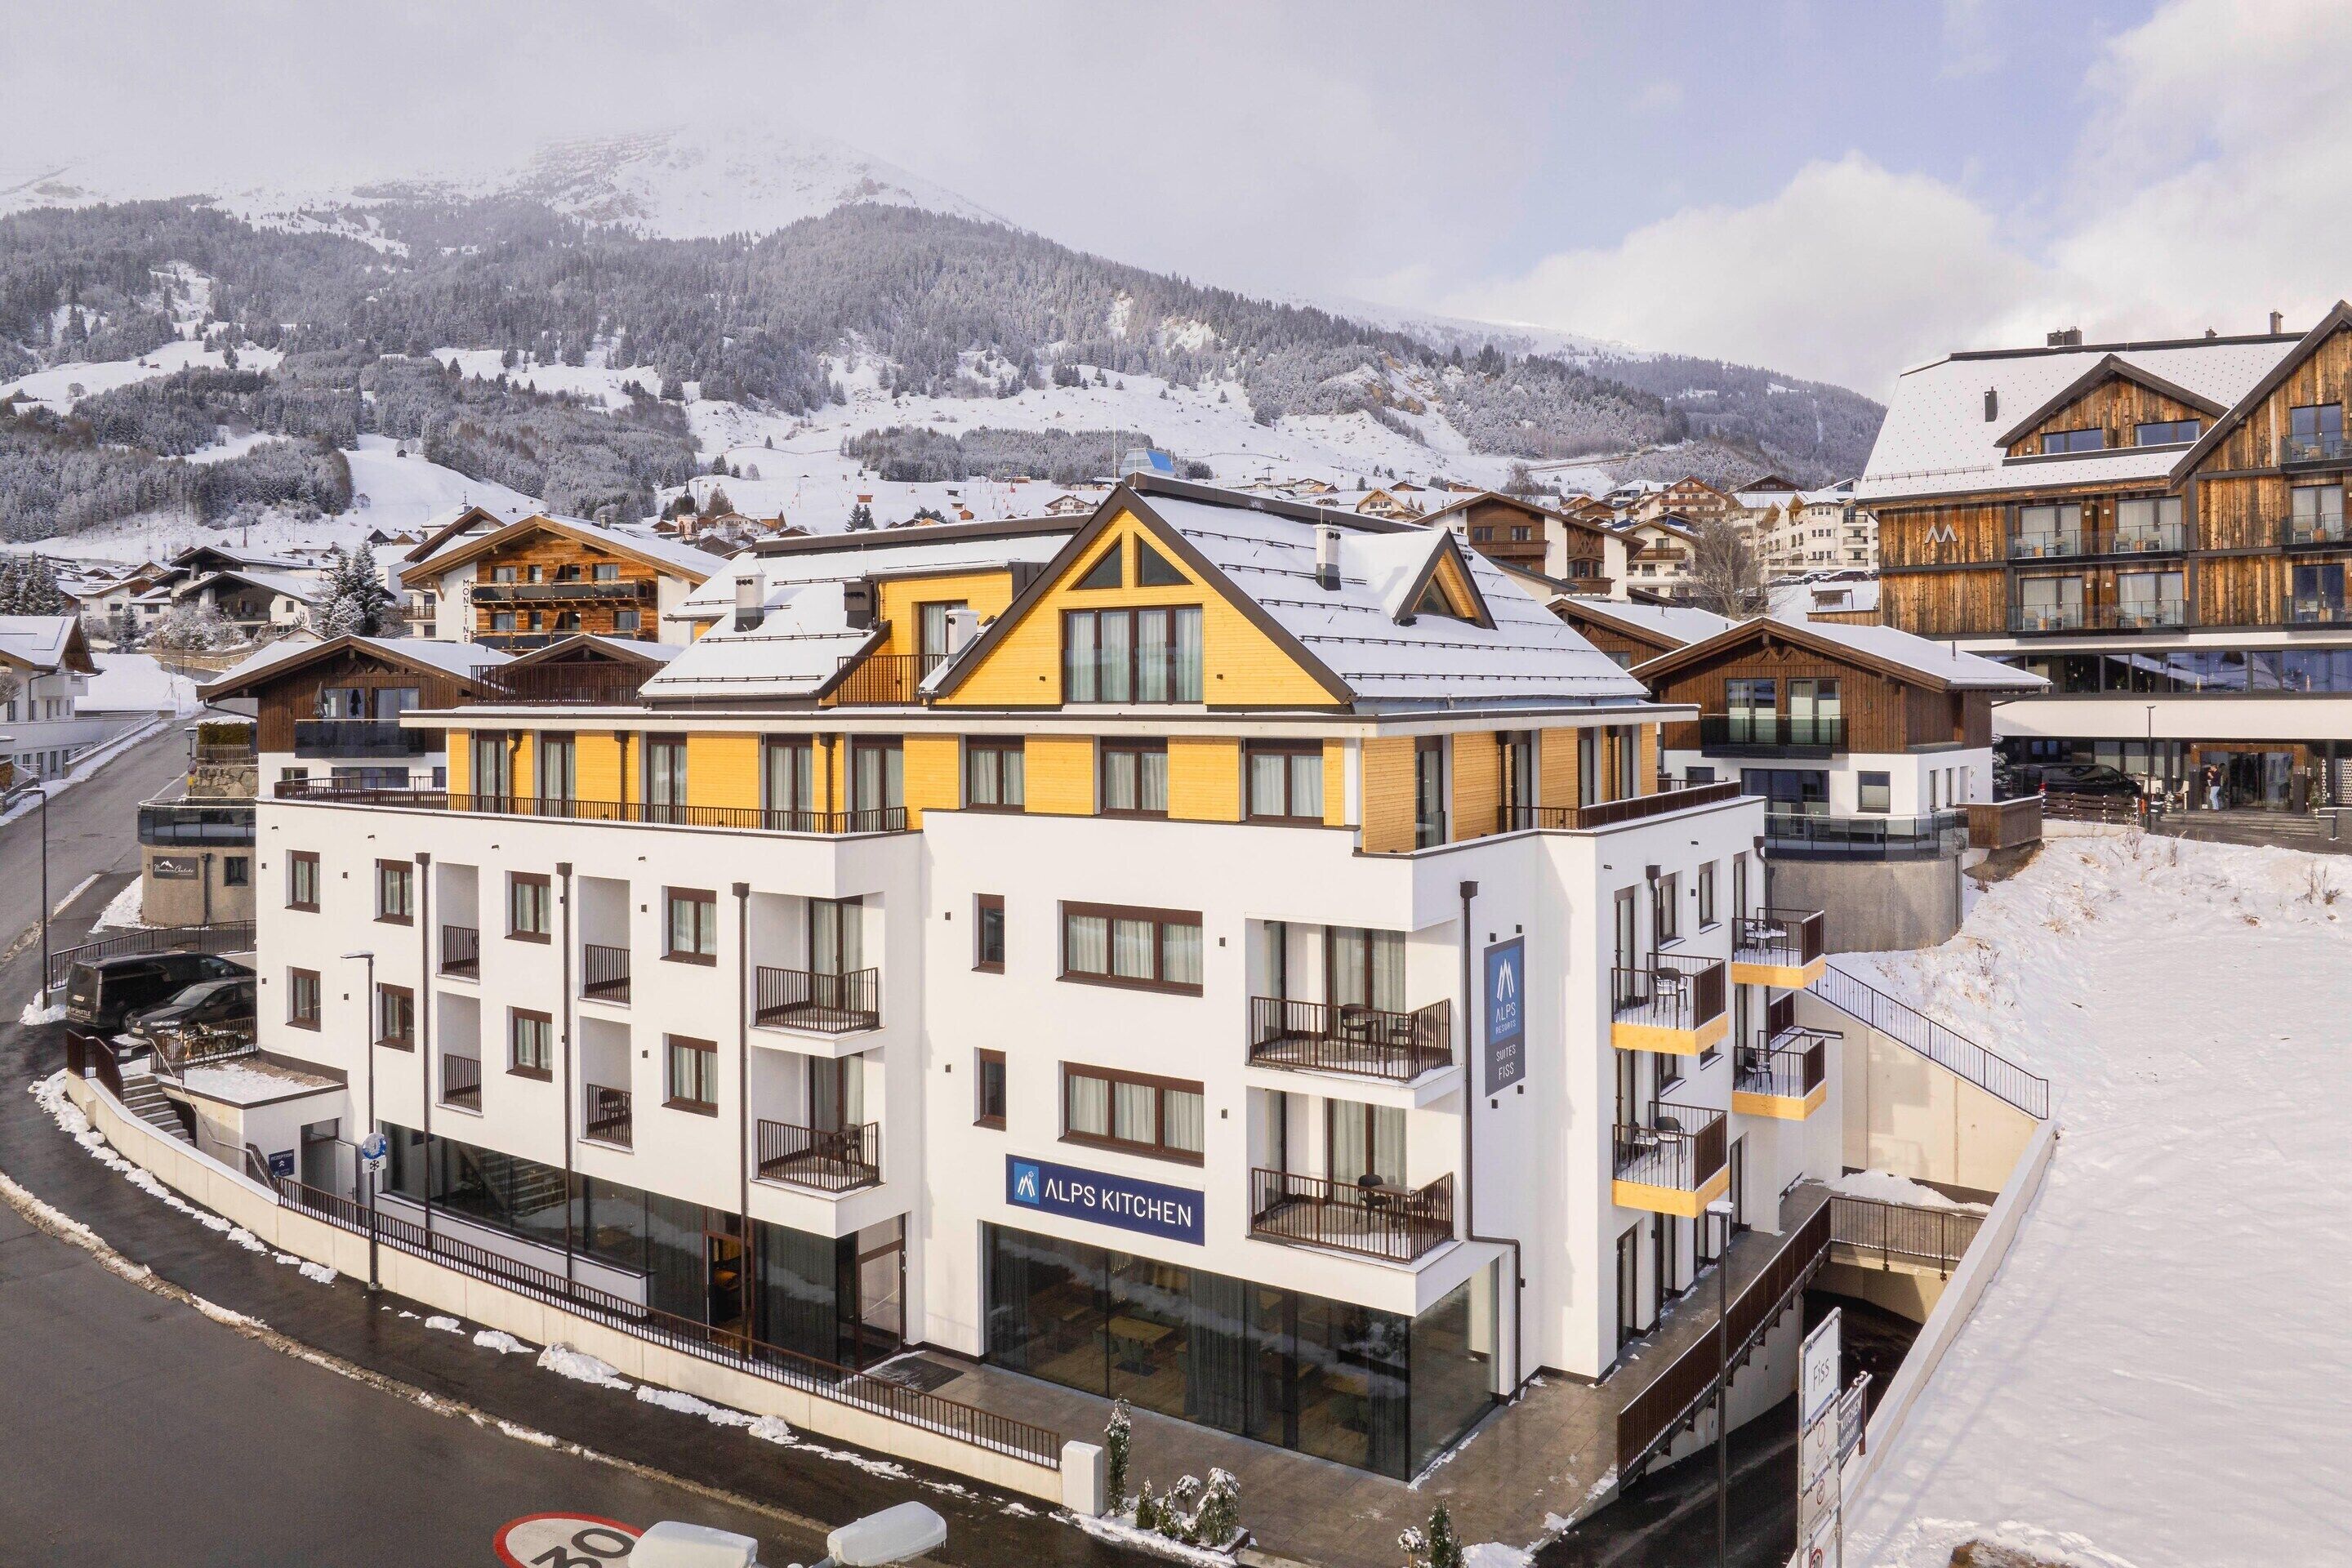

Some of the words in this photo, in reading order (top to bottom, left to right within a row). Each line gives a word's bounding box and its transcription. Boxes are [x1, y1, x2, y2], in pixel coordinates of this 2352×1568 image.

[1495, 1001, 1516, 1023] ALPS
[1495, 1019, 1517, 1036] RESORTS
[1495, 1044, 1517, 1062] SUITES
[1498, 1062, 1514, 1081] FISS
[1045, 1178, 1096, 1208] ALPS
[1102, 1188, 1192, 1227] KITCHEN
[1813, 1357, 1829, 1392] Fiss
